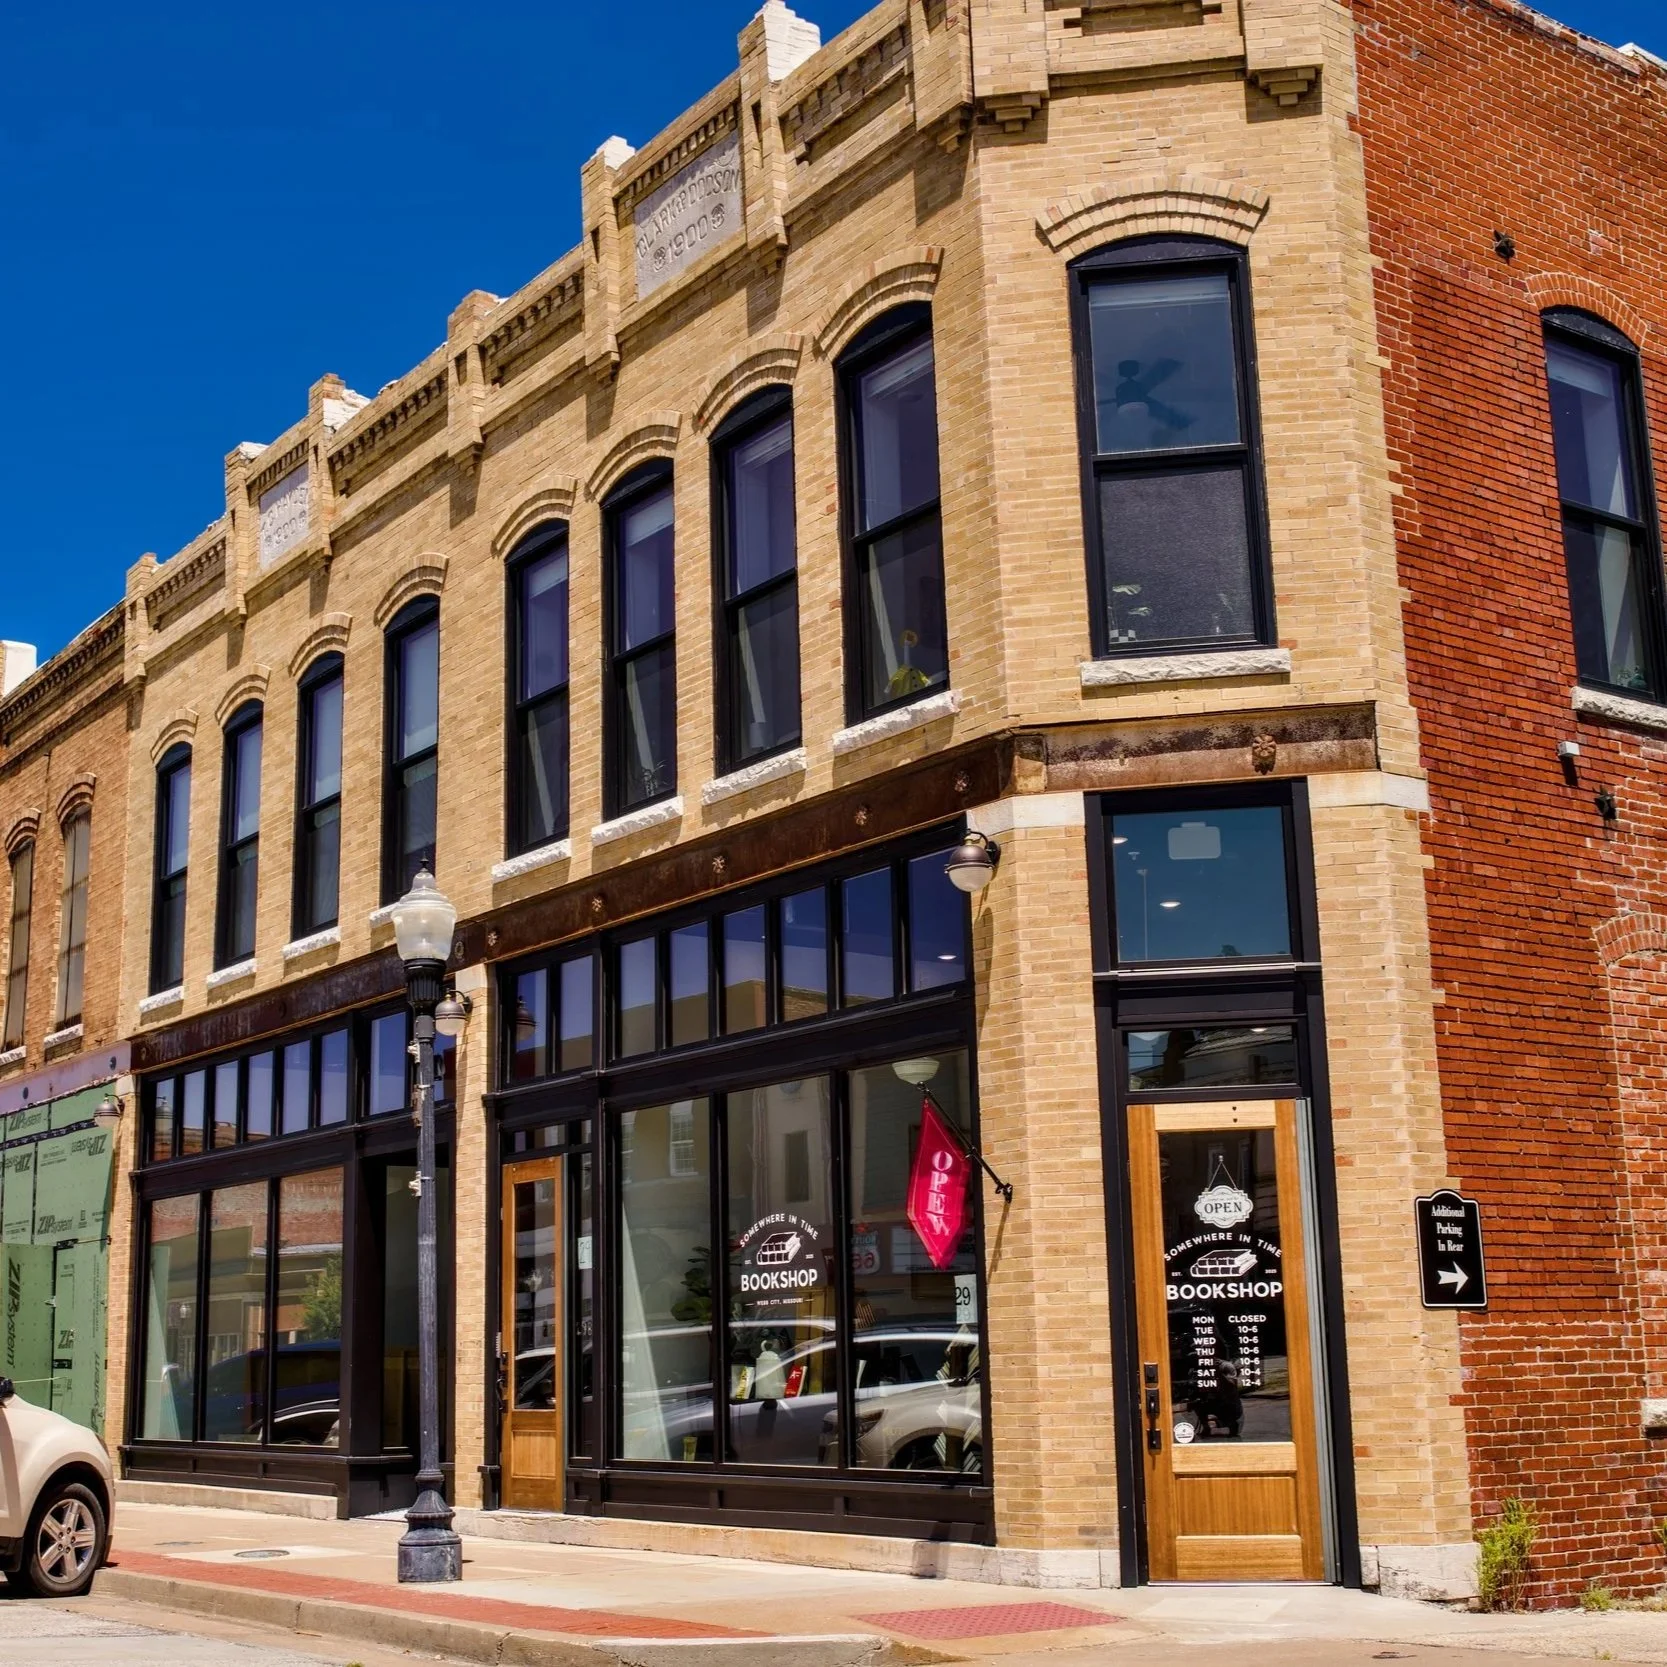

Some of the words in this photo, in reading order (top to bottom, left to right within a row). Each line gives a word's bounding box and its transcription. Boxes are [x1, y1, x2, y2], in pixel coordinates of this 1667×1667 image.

[667, 215, 708, 263] 1900
[926, 1151, 953, 1236] OPEN
[1204, 1201, 1243, 1214] OPEN
[1431, 1205, 1466, 1217] Additional
[740, 1213, 785, 1248] SOMEWHERE
[788, 1214, 798, 1225] IN
[800, 1219, 818, 1241] TIME
[1436, 1222, 1463, 1237] Parking
[1164, 1232, 1233, 1261] SOMEWHERE
[1239, 1233, 1251, 1243] IN
[1257, 1239, 1283, 1258] TIME
[1438, 1240, 1446, 1251] In
[1447, 1240, 1464, 1252] Rear
[741, 1268, 818, 1292] BOOKSHOP
[1166, 1281, 1283, 1300] BOOKSHOP
[1192, 1316, 1215, 1324] MON
[1228, 1315, 1267, 1323] CLOSED
[1195, 1327, 1214, 1335] TUE
[1237, 1325, 1258, 1333] 10-6
[1194, 1337, 1216, 1345] WED
[1238, 1336, 1259, 1344] 10-6
[1195, 1348, 1215, 1356] THU
[1239, 1347, 1260, 1355] 10-6
[1198, 1358, 1214, 1366] FRI
[1240, 1357, 1260, 1365] 10-6
[1197, 1369, 1216, 1377] SAT
[1240, 1368, 1261, 1376] 10-4
[1197, 1379, 1217, 1388] SUN
[1241, 1379, 1262, 1387] 12-4
